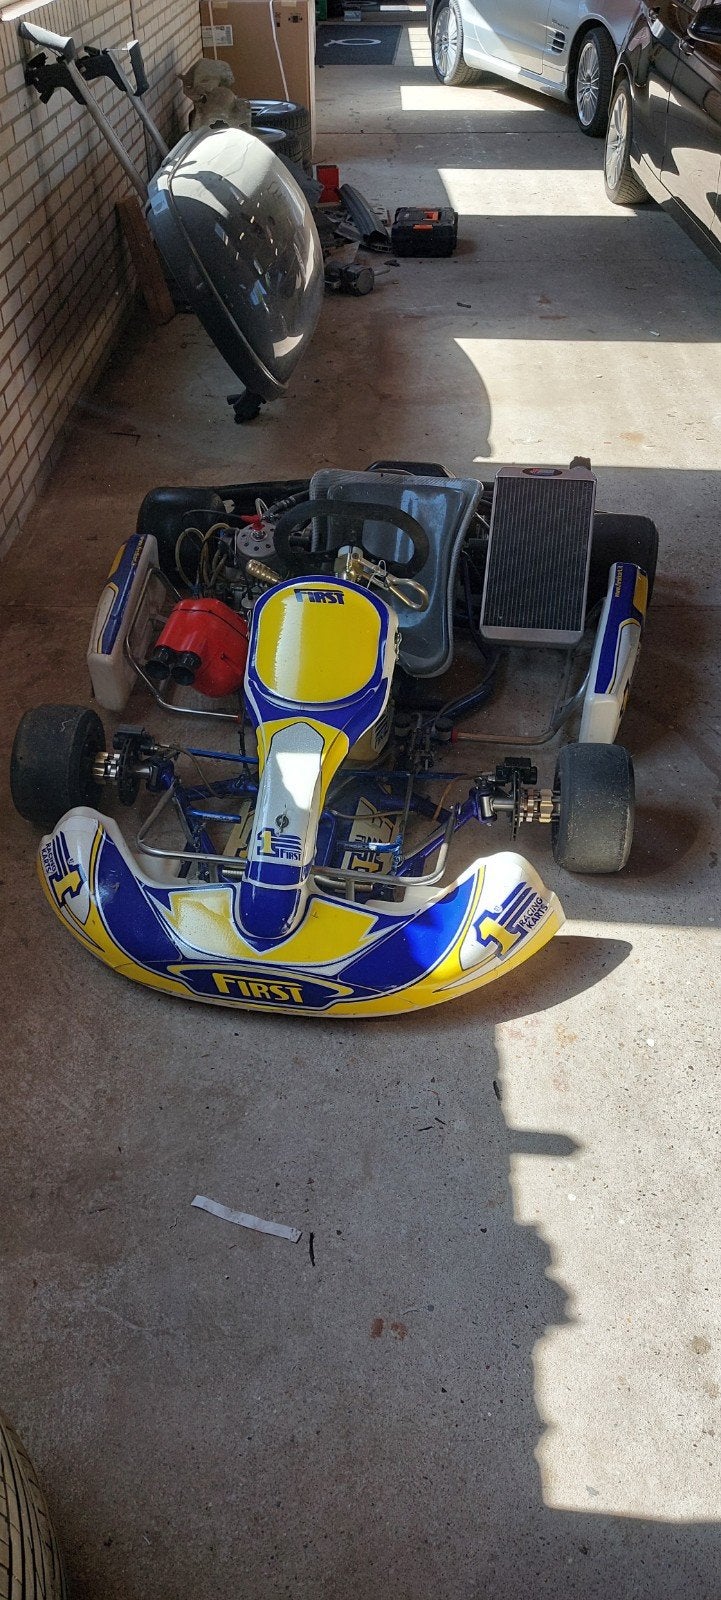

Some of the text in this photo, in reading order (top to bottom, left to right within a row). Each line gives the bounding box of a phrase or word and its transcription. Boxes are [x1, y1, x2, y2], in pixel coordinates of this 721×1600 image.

[294, 588, 345, 605] FIRST
[518, 897, 543, 927] RACING
[526, 902, 549, 930] KARTS
[212, 972, 304, 1003] FIRST
